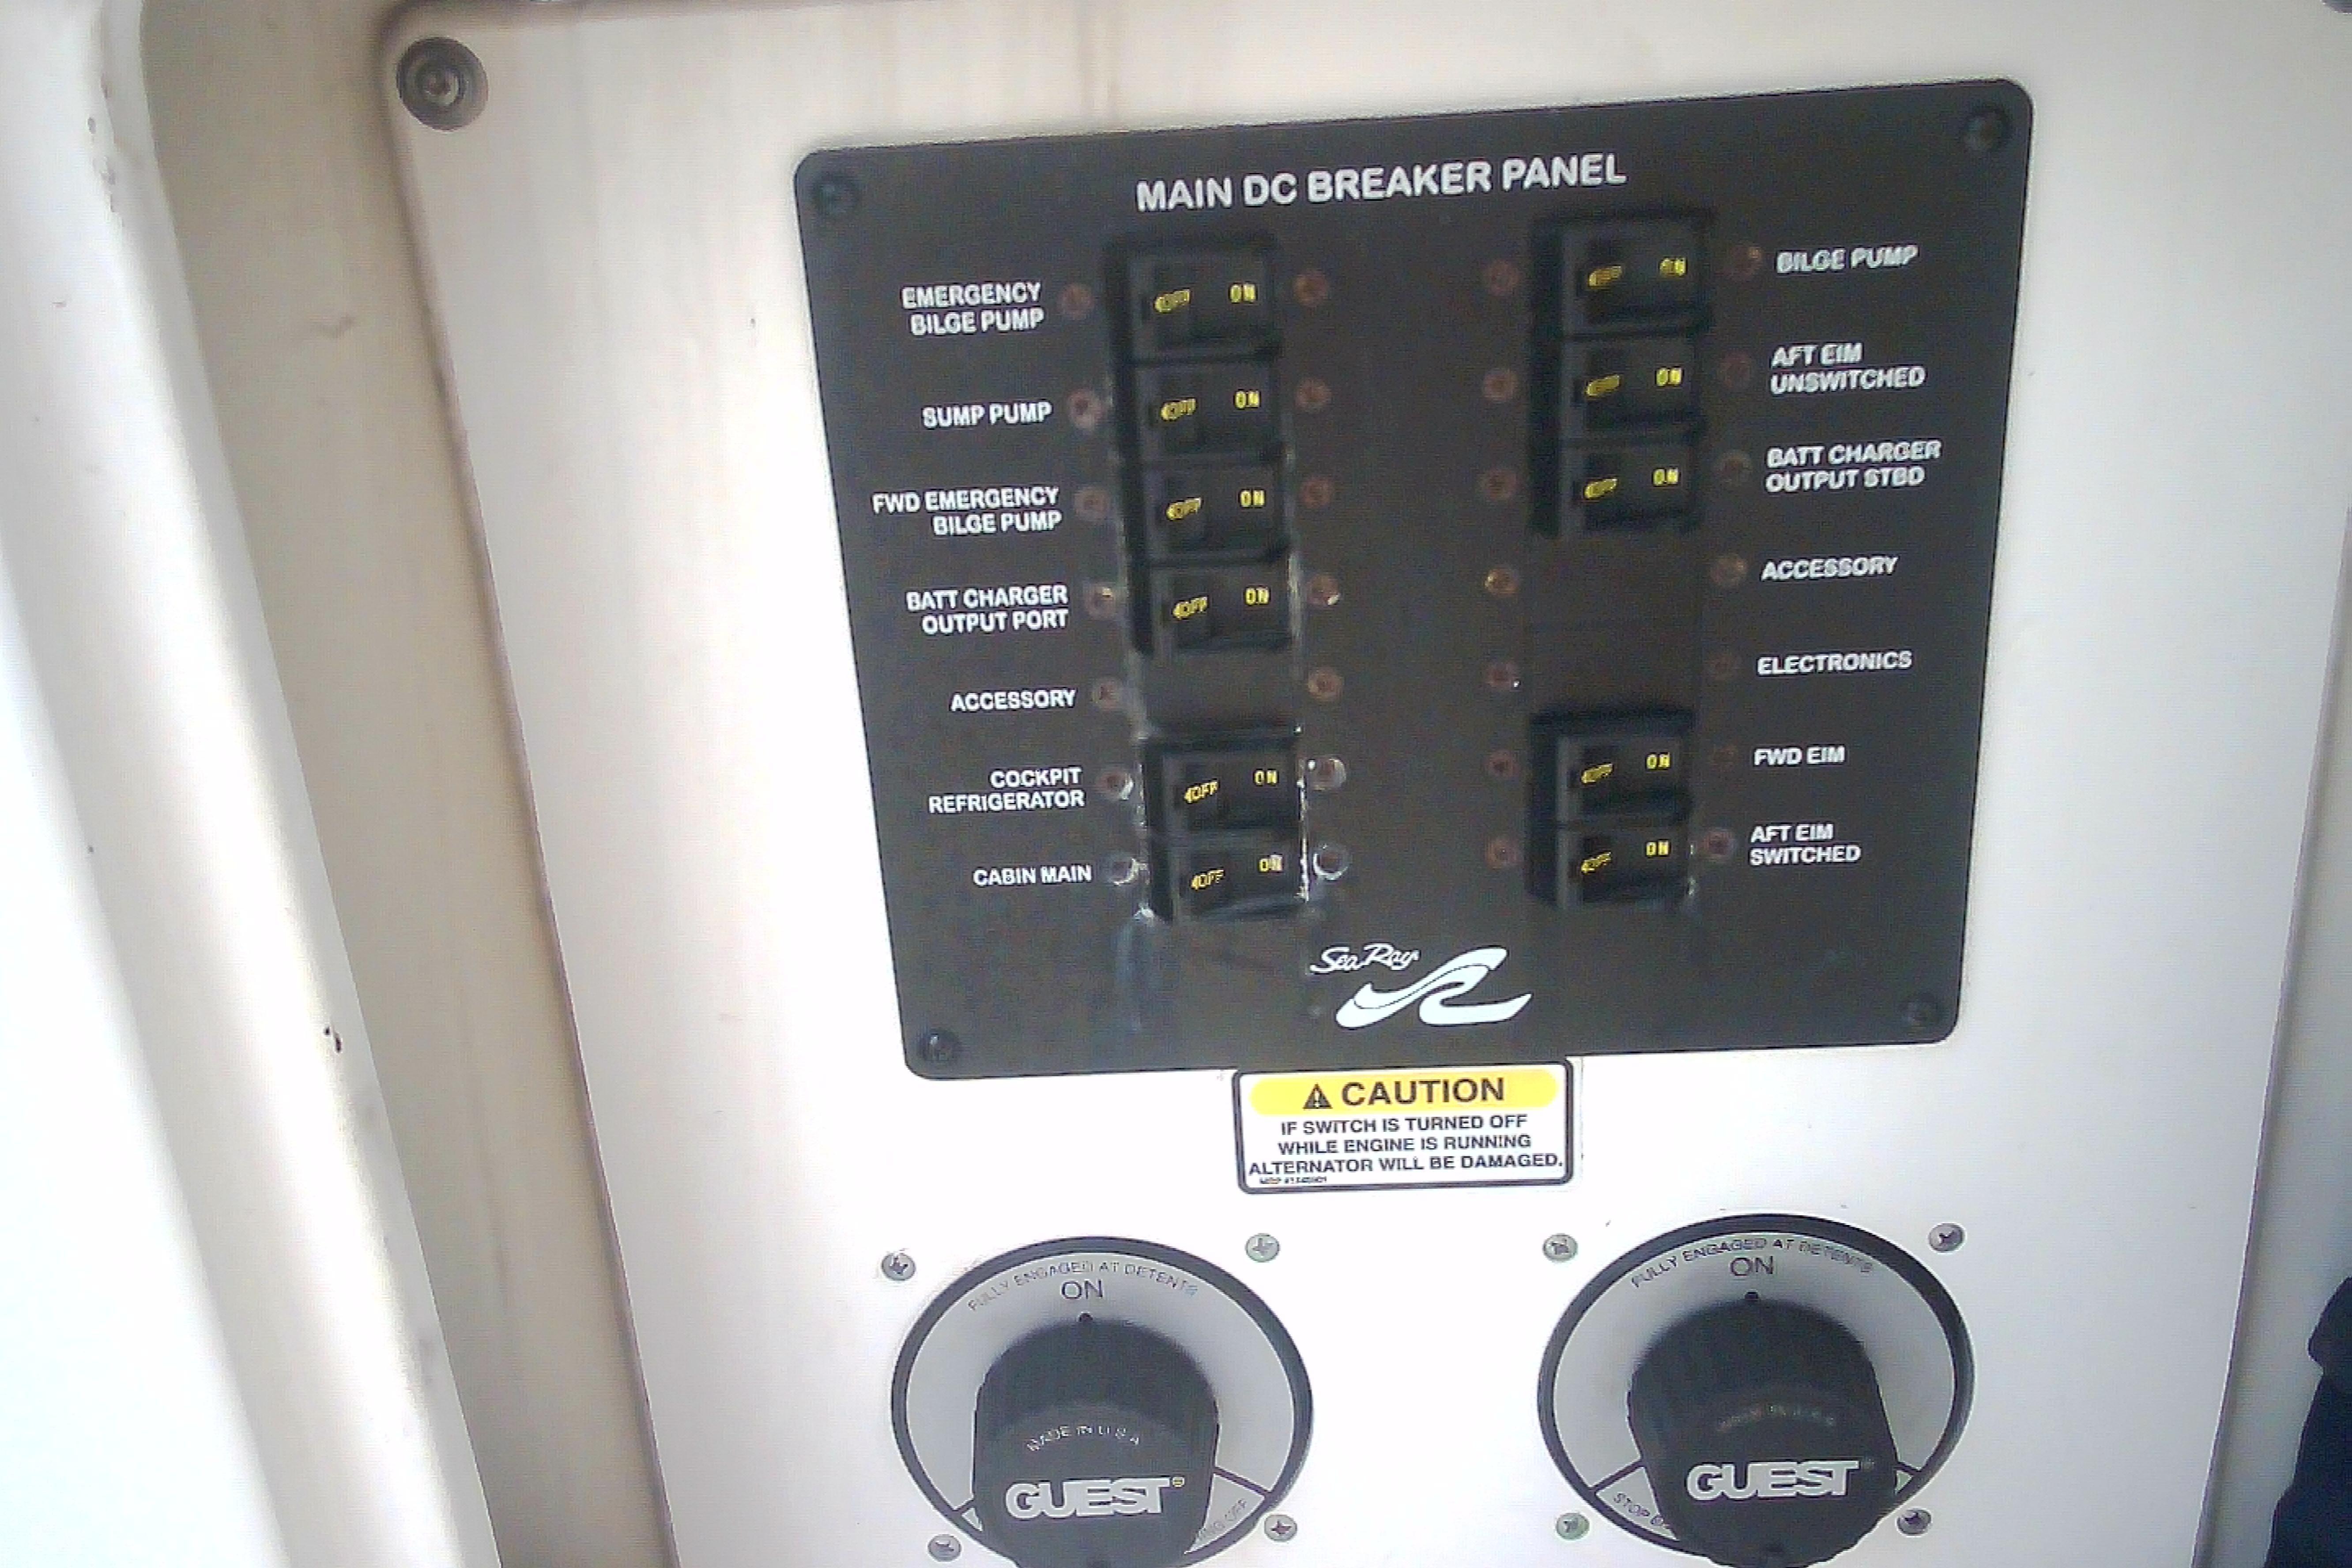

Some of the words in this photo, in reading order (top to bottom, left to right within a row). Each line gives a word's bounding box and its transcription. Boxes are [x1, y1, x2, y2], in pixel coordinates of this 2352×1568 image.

[1136, 177, 1233, 211] MAIN
[1243, 172, 1298, 207] DC
[1308, 161, 1492, 203] BREAKER
[1502, 152, 1627, 192] PANEL
[1660, 259, 1686, 277] ON
[1776, 249, 1846, 274] BILGE
[1850, 244, 1919, 269] PUMP
[901, 282, 1044, 312] EMERGENCY
[1229, 285, 1256, 303] ON
[910, 311, 977, 336] BILGE
[980, 308, 1044, 332] PUMP
[1771, 344, 1818, 367] AFT
[1821, 342, 1862, 365] EIM
[1656, 368, 1682, 387] ON
[1770, 363, 1926, 395] UNSWITCHED
[1235, 392, 1259, 409] ON
[922, 404, 985, 427] SUMP
[989, 401, 1052, 426] PUMP
[1767, 445, 1832, 468] BATT
[1831, 439, 1942, 468] CHARGER
[1653, 470, 1678, 486] ON
[1765, 468, 1860, 493] OUTPUT
[1863, 465, 1925, 488] STBD
[872, 491, 921, 514] FWD
[924, 486, 1060, 514] EMERGENCY
[1240, 490, 1265, 506] ON
[932, 513, 997, 535] BILGE
[1000, 509, 1062, 532] PUMP
[1761, 555, 1899, 580] ACCESSORY
[906, 589, 959, 612] BATT
[963, 584, 1069, 611] CHARGER
[1245, 589, 1269, 606] ON
[922, 612, 1008, 635] OUTPUT
[1012, 609, 1069, 630] PORT
[1757, 650, 1912, 675] ELECTRONICS
[950, 689, 1076, 712] ACCESSORY
[1646, 754, 1671, 769] ON
[1754, 746, 1803, 766] FWD
[1806, 745, 1845, 765] EIM
[990, 766, 1082, 789] COCKPIT
[1192, 781, 1218, 802] OFF
[1254, 772, 1278, 784] ON
[928, 789, 1085, 814] REFRIGERATOR
[1750, 825, 1793, 843] AFT
[1795, 823, 1834, 841] EIM
[1646, 841, 1670, 856] ON
[1749, 844, 1862, 866] SWITCHED
[972, 867, 1037, 886] CABIN
[1040, 864, 1092, 884] MAIN
[1259, 854, 1283, 872] ON
[1309, 946, 1359, 973] Sea
[1358, 942, 1420, 970] Ray
[1342, 1077, 1504, 1106] CAUTION
[1281, 1121, 1297, 1136] IF
[1303, 1119, 1377, 1136] SWITCH
[1382, 1118, 1400, 1133] IS
[1404, 1115, 1484, 1131] TURNED
[1489, 1113, 1527, 1129] OFF
[1278, 1140, 1338, 1156] WHILE
[1344, 1138, 1415, 1154] ENGINE
[1421, 1136, 1438, 1150] IS
[1444, 1134, 1531, 1150] RUNNING
[1248, 1159, 1373, 1175] ALTERNATOR
[1378, 1157, 1425, 1172] WILL
[1429, 1155, 1455, 1170] BE
[1461, 1152, 1563, 1168] DAMAGED.
[1099, 1261, 1120, 1273] AT
[1632, 1256, 1678, 1288] FULLY
[1682, 1238, 1767, 1262] ENGAGED
[1772, 1238, 1794, 1250] AT
[1730, 1255, 1775, 1277] ON
[1061, 1280, 1104, 1301] ON
[1685, 1459, 1861, 1502] GUEST
[1006, 1477, 1171, 1519] GUEST
[1613, 1493, 1651, 1517] STOP
